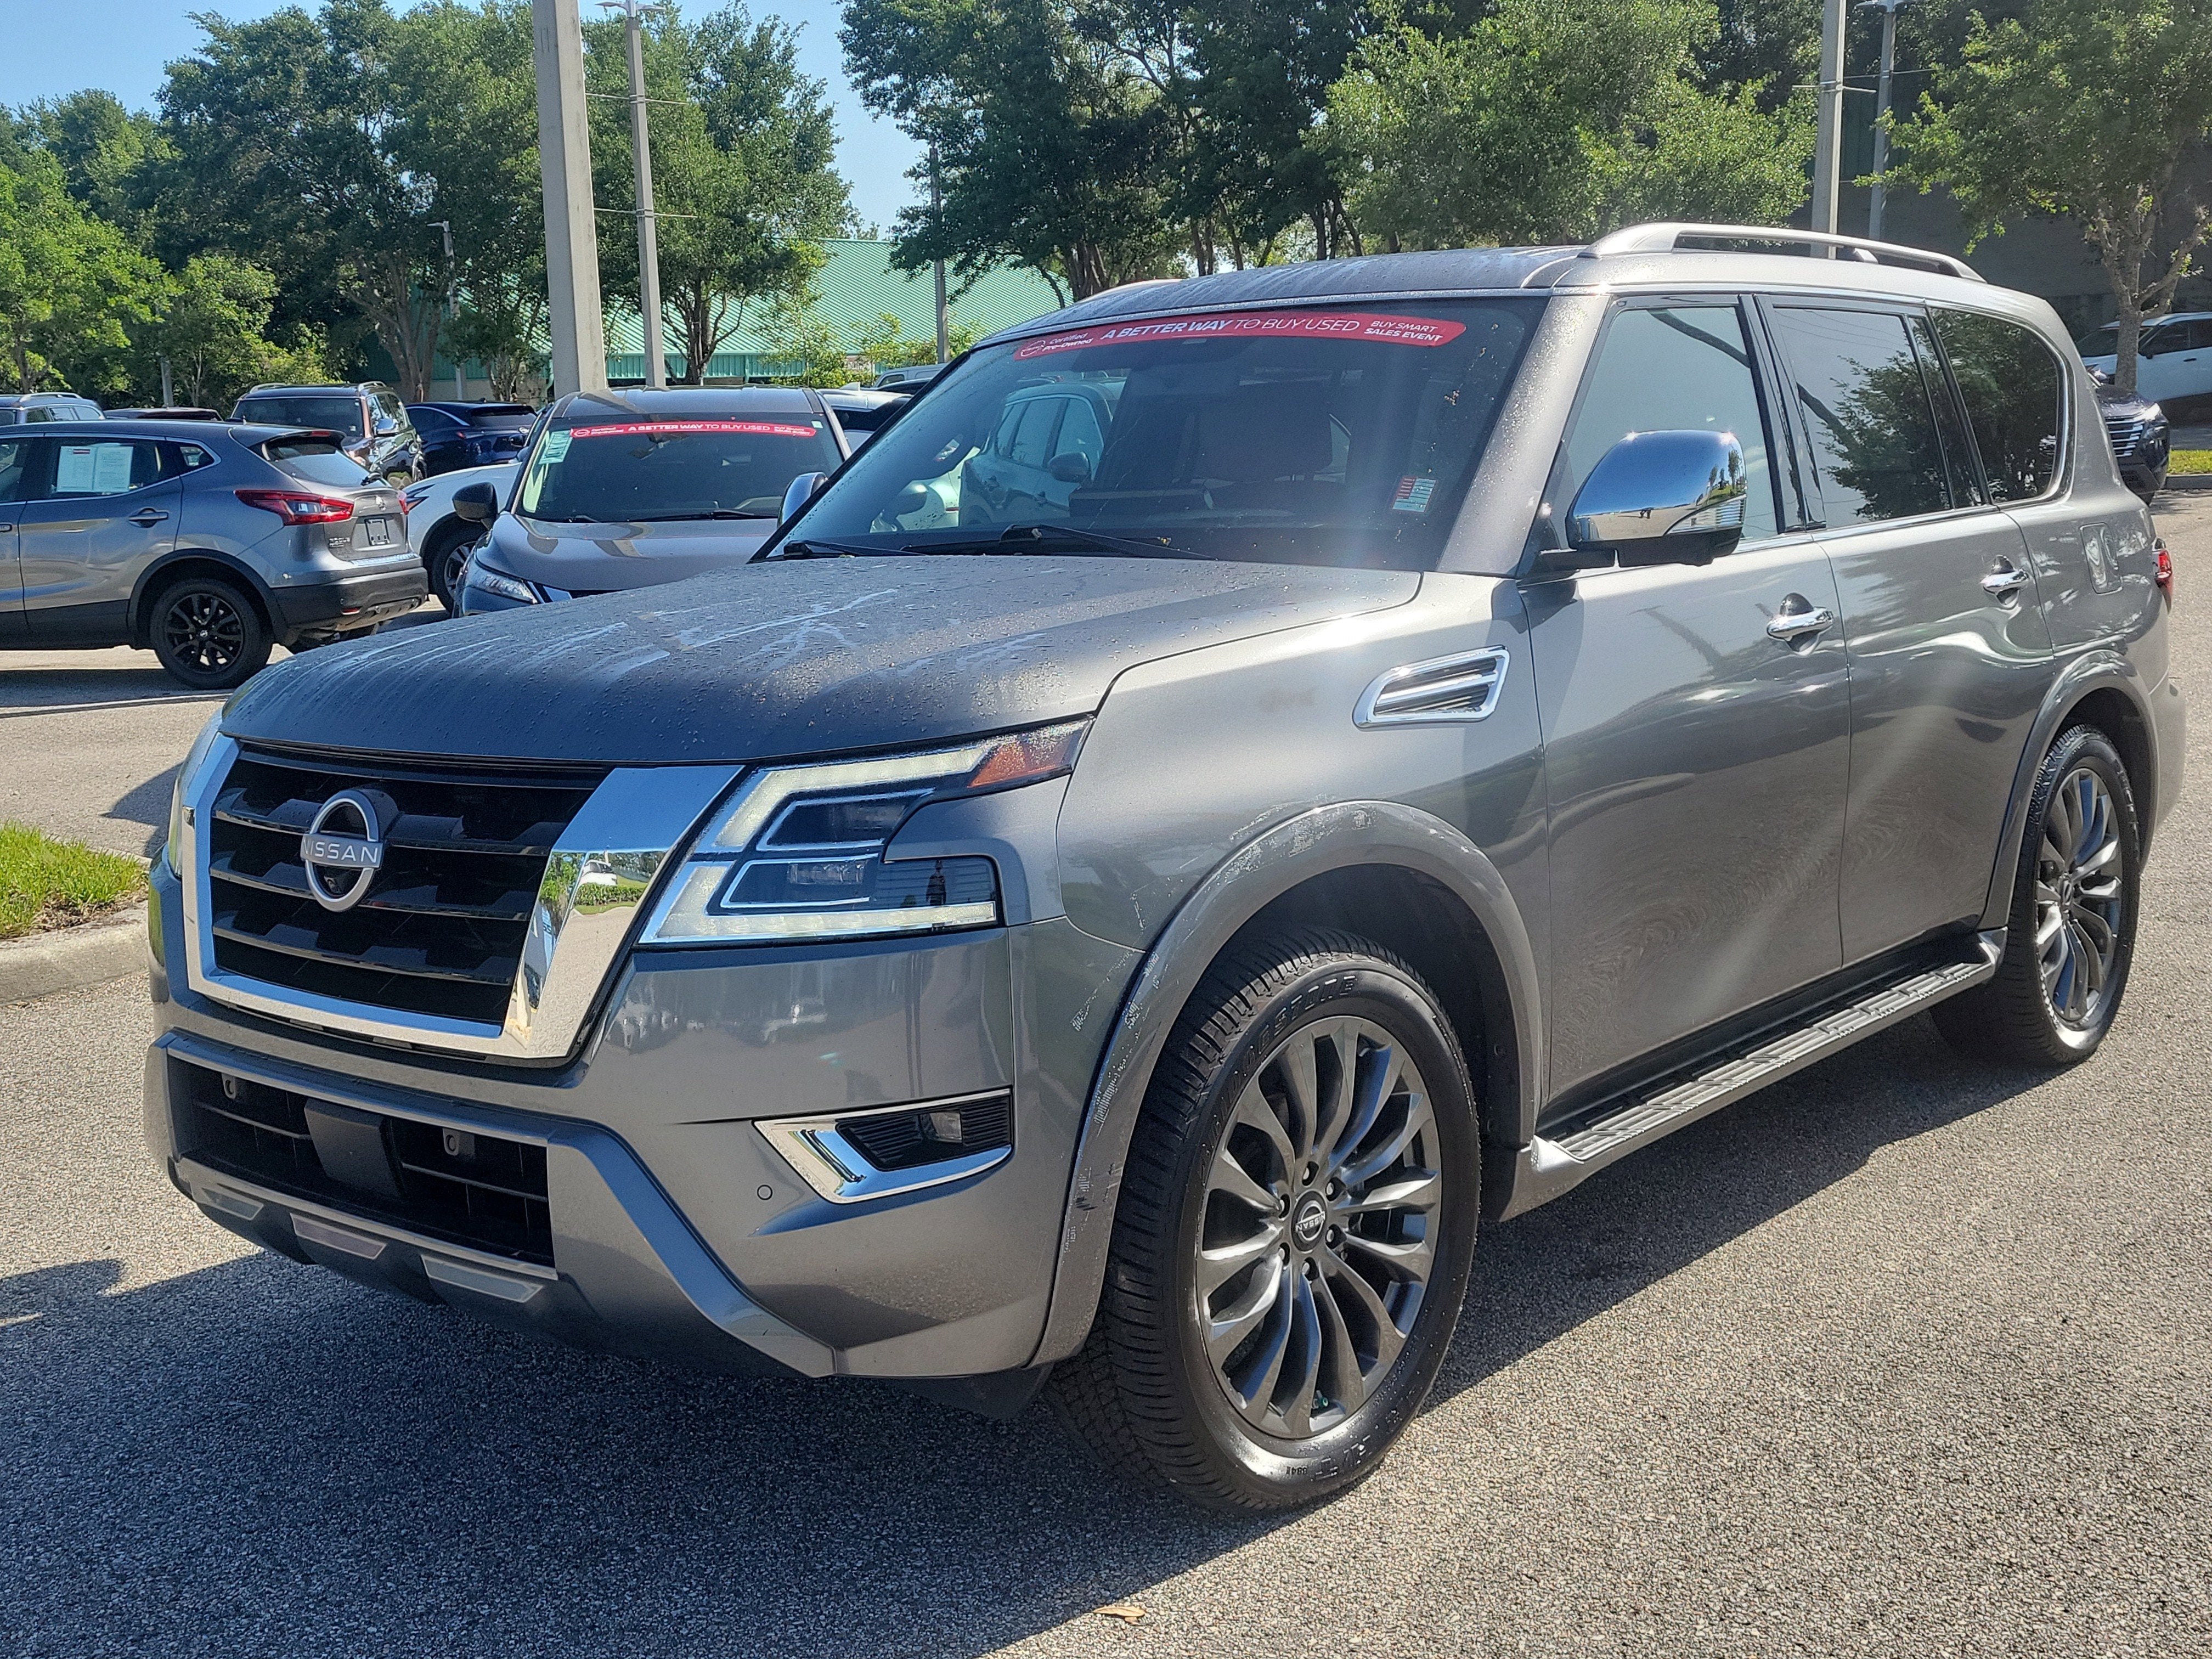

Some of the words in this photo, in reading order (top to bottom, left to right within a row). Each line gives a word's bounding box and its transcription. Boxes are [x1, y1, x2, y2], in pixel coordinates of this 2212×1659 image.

[1101, 329, 1117, 340] A
[1116, 322, 1188, 337] BETTER
[1188, 320, 1234, 331] WAY
[1234, 319, 1261, 329] TO
[1261, 319, 1306, 329] BUY
[1305, 319, 1360, 331] USED
[1364, 328, 1402, 336] SALES
[1402, 331, 1443, 341] EVENT
[1395, 323, 1438, 332] SMART
[303, 838, 378, 864] NISSAN
[1296, 1214, 1325, 1232] NISSAN
